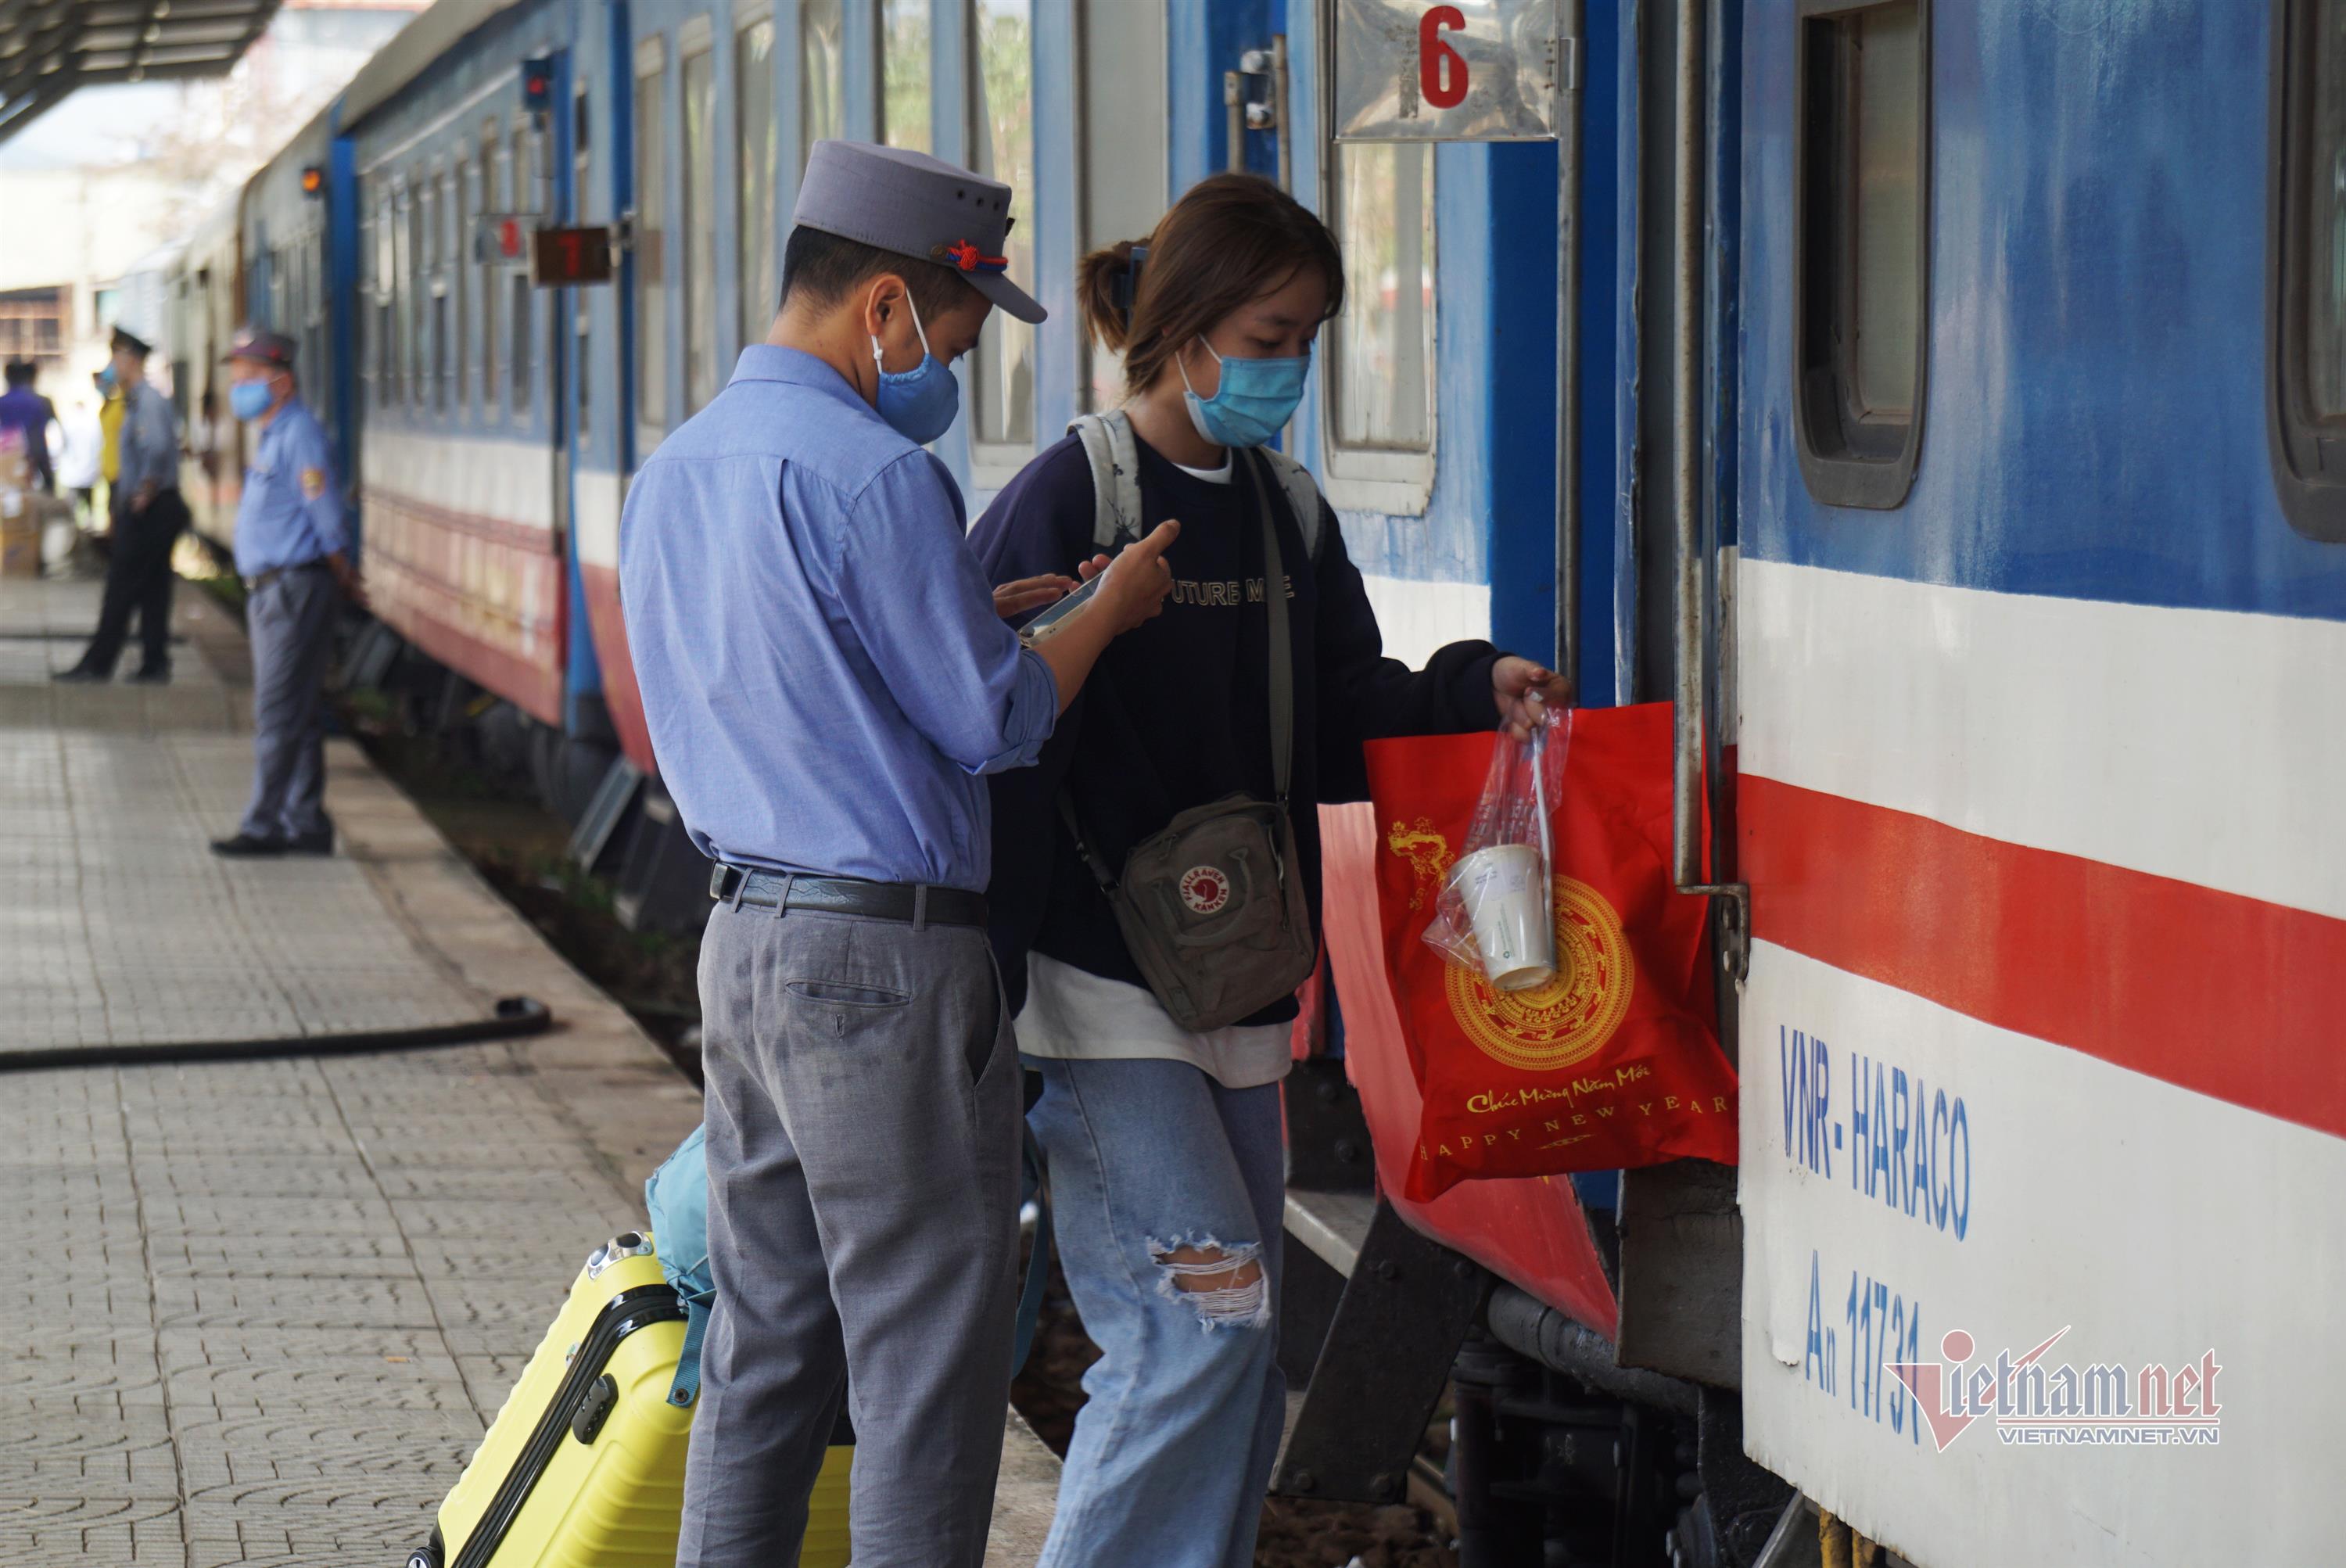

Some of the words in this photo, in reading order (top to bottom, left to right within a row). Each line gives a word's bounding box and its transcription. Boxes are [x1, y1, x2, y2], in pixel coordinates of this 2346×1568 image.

[1419, 5, 1469, 109] 6
[1161, 579, 1241, 606] UTURE
[1465, 1089, 1519, 1114] Chúc
[1571, 1077, 1616, 1097] Năm
[1419, 1128, 1521, 1161] HAPPY
[1544, 1106, 1616, 1132] NEW
[1638, 1096, 1729, 1116] YEAR
[1846, 1269, 1918, 1445] 11731
